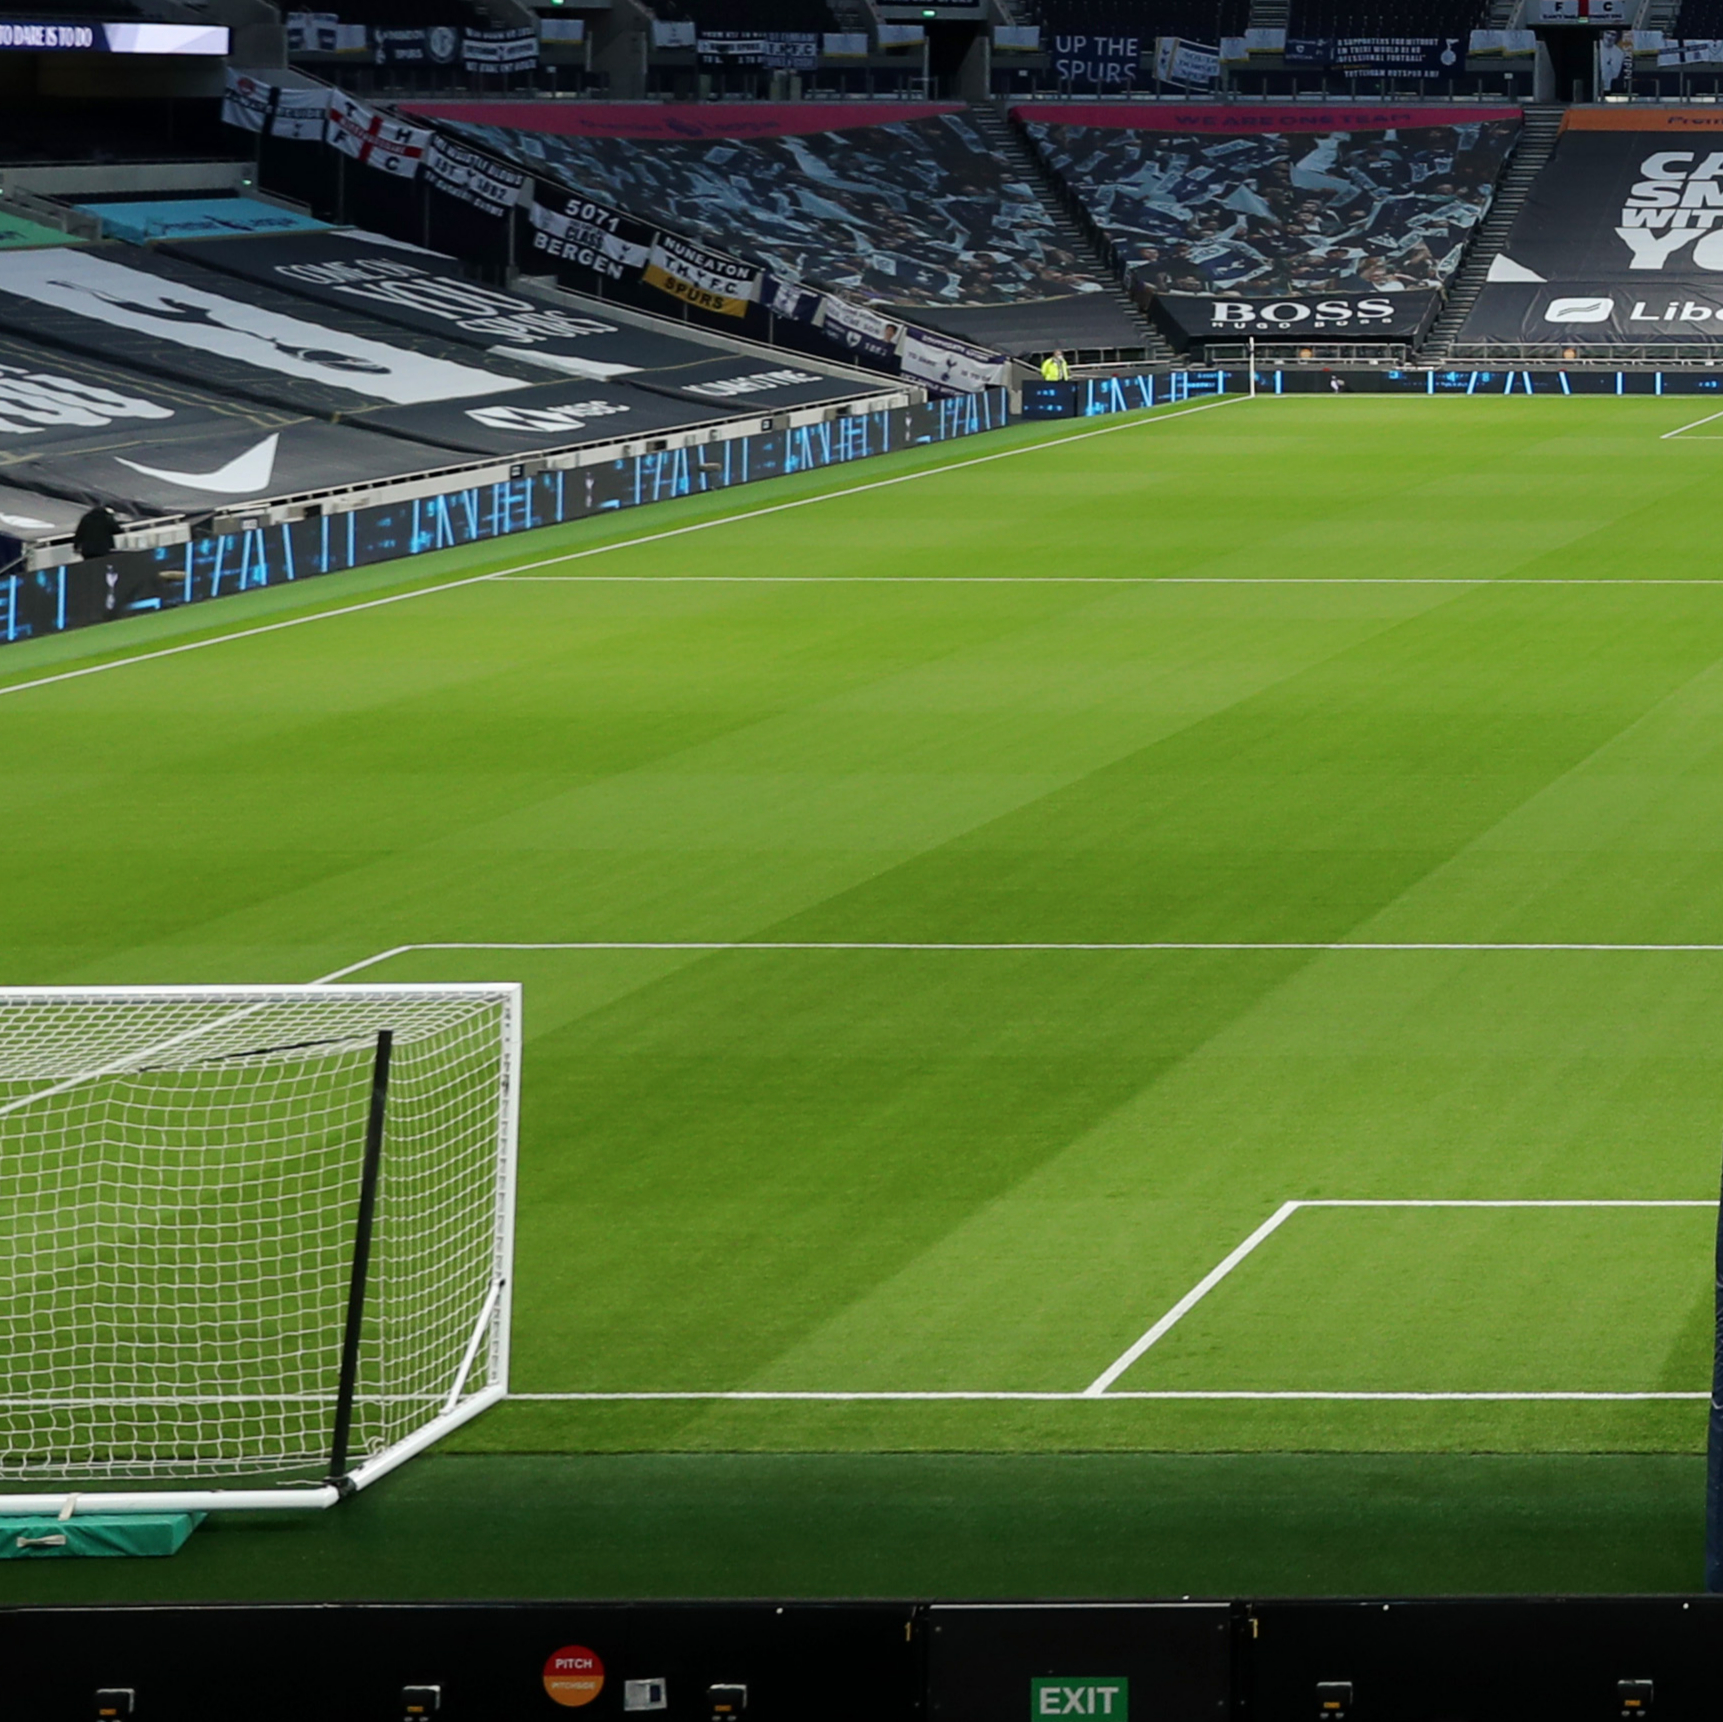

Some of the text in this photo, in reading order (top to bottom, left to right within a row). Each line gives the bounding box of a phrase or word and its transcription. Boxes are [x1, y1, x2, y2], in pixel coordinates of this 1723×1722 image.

[1555, 2, 1613, 12] F C
[13, 25, 93, 48] DARE IS TO DO
[1056, 35, 1139, 57] UP THE
[1056, 59, 1138, 83] SPURS
[395, 129, 412, 143] H
[333, 130, 400, 170] F C
[564, 198, 621, 233] 5071
[533, 231, 625, 280] BERGEN
[663, 236, 751, 280] NUNEATON
[334, 276, 537, 319] YOU
[665, 276, 724, 310] SPURS
[1211, 298, 1395, 323] BOSS
[1212, 317, 1393, 330] HUGO BOSS
[455, 309, 619, 344] SPURS
[555, 1658, 593, 1669] PITCH
[1039, 1686, 1120, 1715] EXIT
